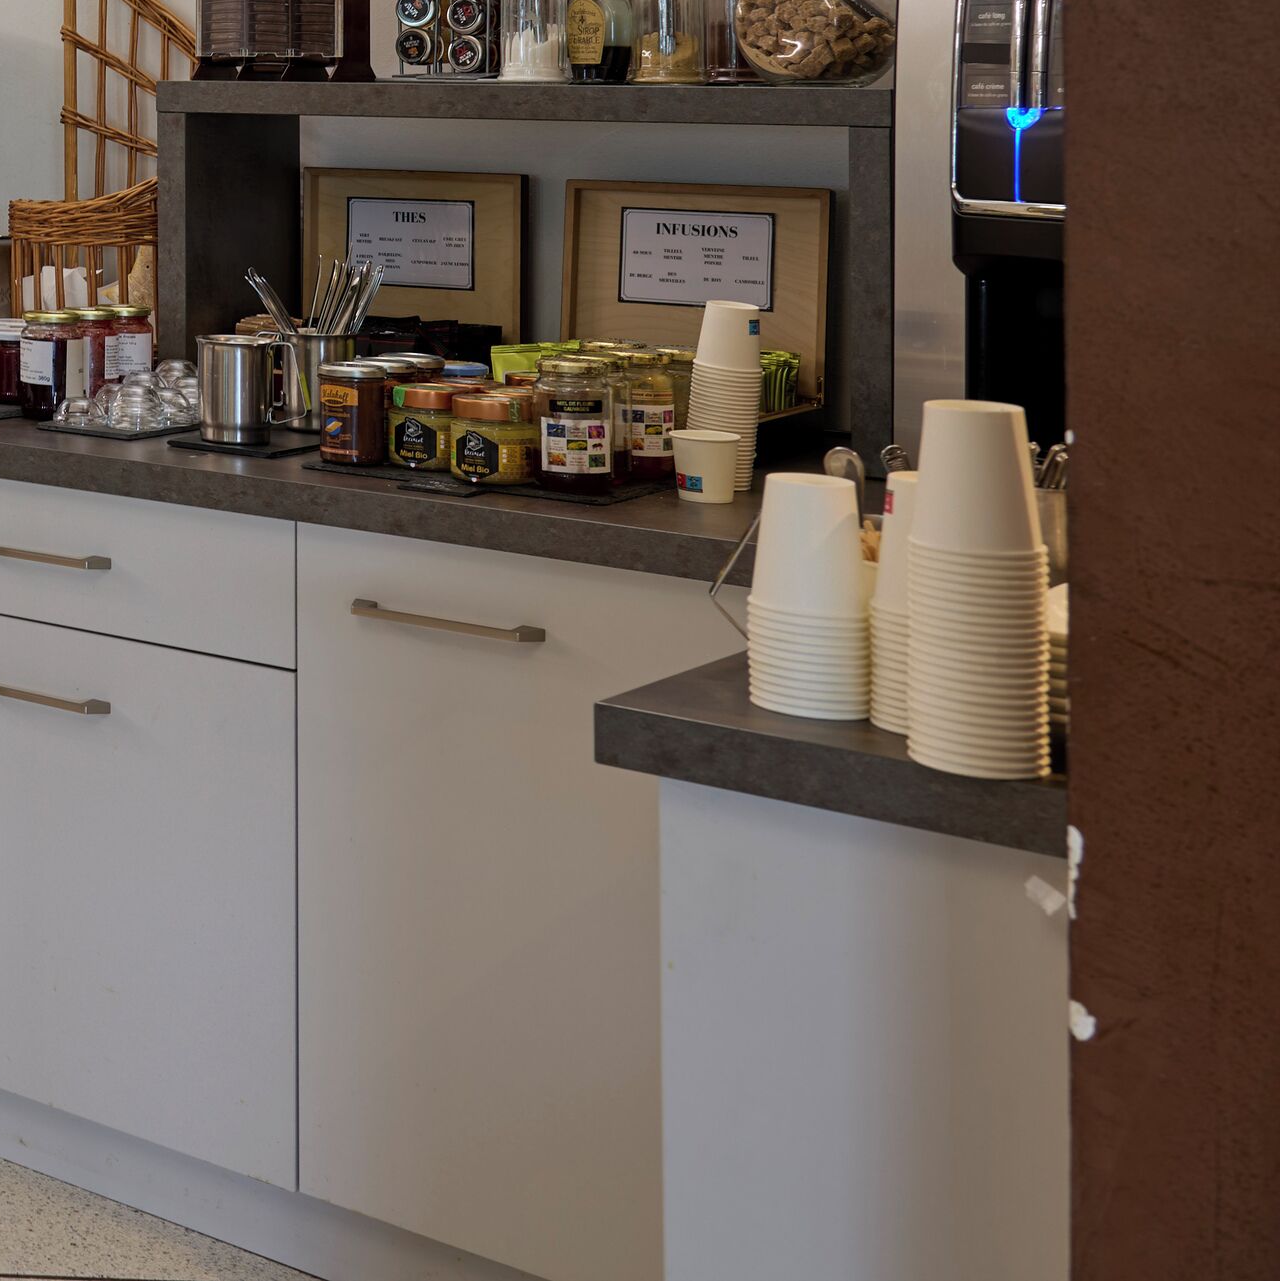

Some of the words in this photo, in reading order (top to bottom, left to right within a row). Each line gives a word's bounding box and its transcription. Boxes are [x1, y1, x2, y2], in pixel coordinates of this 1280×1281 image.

[992, 12, 1005, 20] long
[972, 82, 984, 90] café
[985, 82, 1004, 90] crème
[392, 211, 426, 223] THES
[656, 222, 738, 238] INFUSIONS
[400, 450, 414, 458] Miel
[415, 451, 428, 459] Bio
[461, 464, 475, 472] Miel
